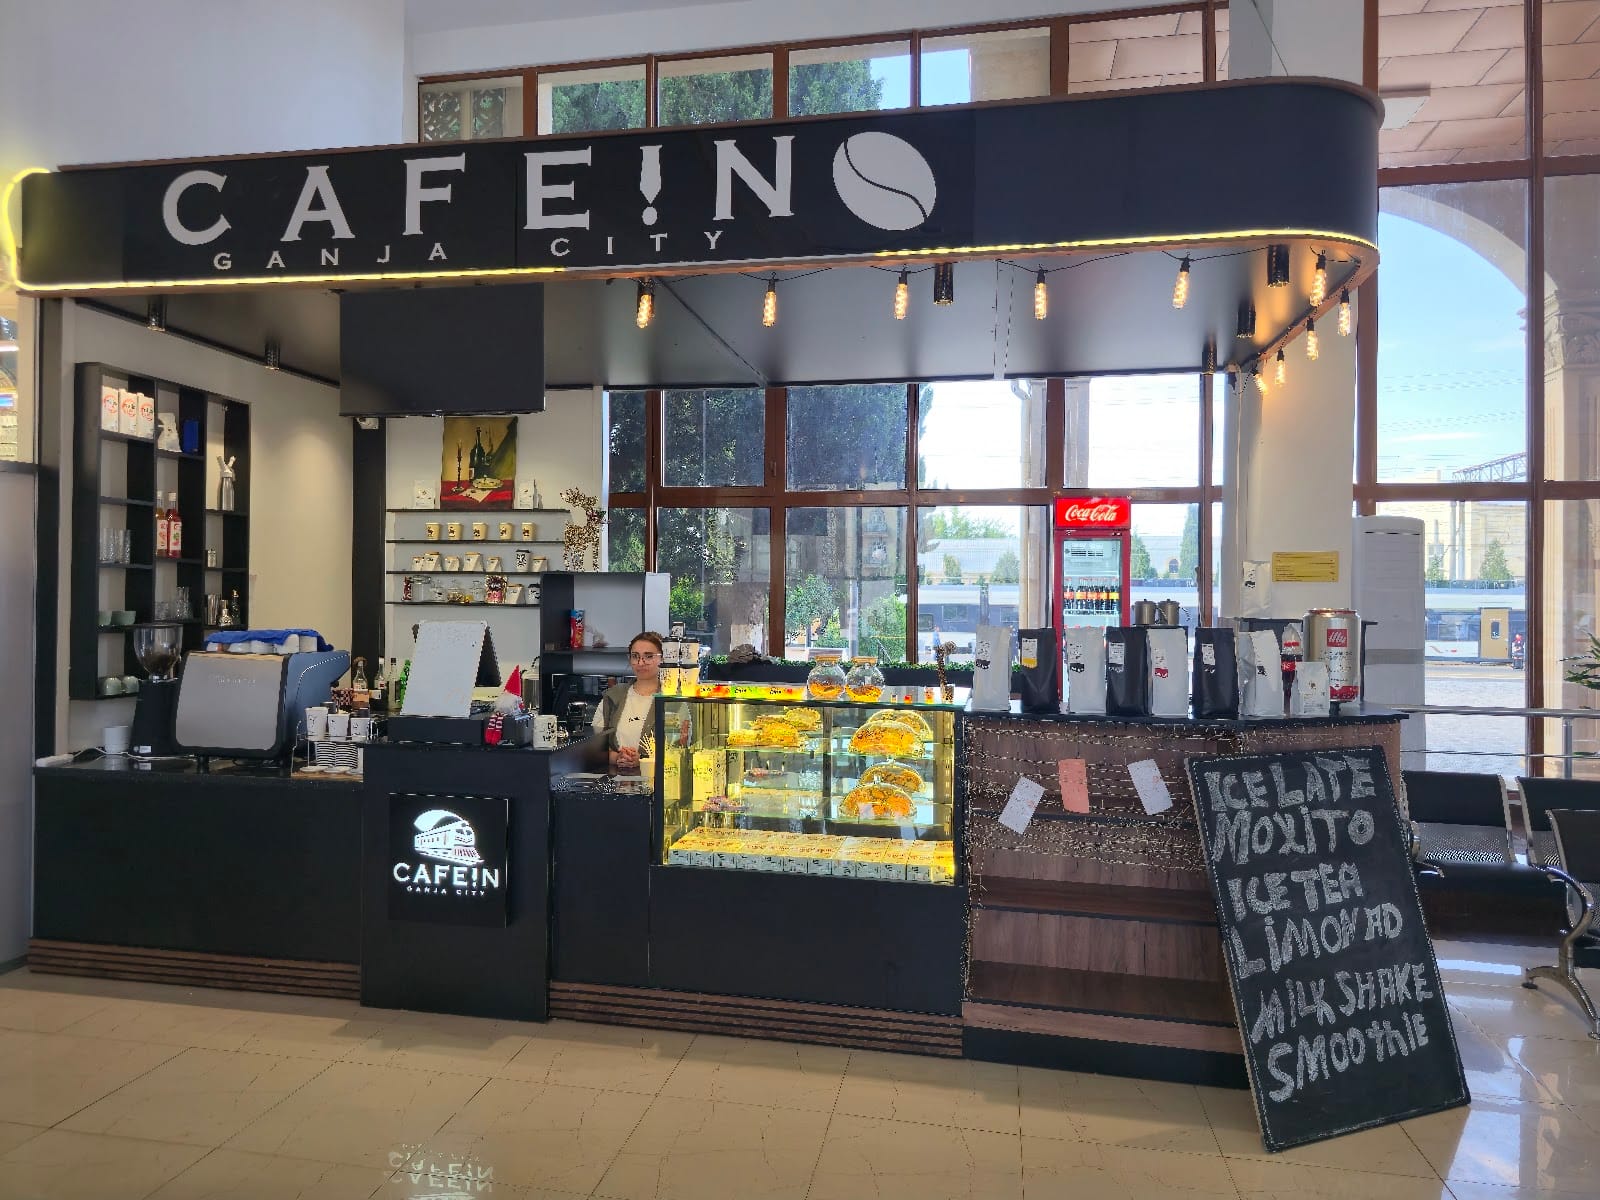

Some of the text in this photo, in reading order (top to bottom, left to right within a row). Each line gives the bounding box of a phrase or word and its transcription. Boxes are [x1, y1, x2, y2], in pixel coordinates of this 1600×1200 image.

[212, 229, 725, 272] GANJA CITY
[1204, 755, 1376, 812] ICE LATE
[406, 885, 485, 897] GANJA CITY
[1227, 862, 1364, 922] ICE TEA
[1334, 963, 1434, 1017] SHAKE
